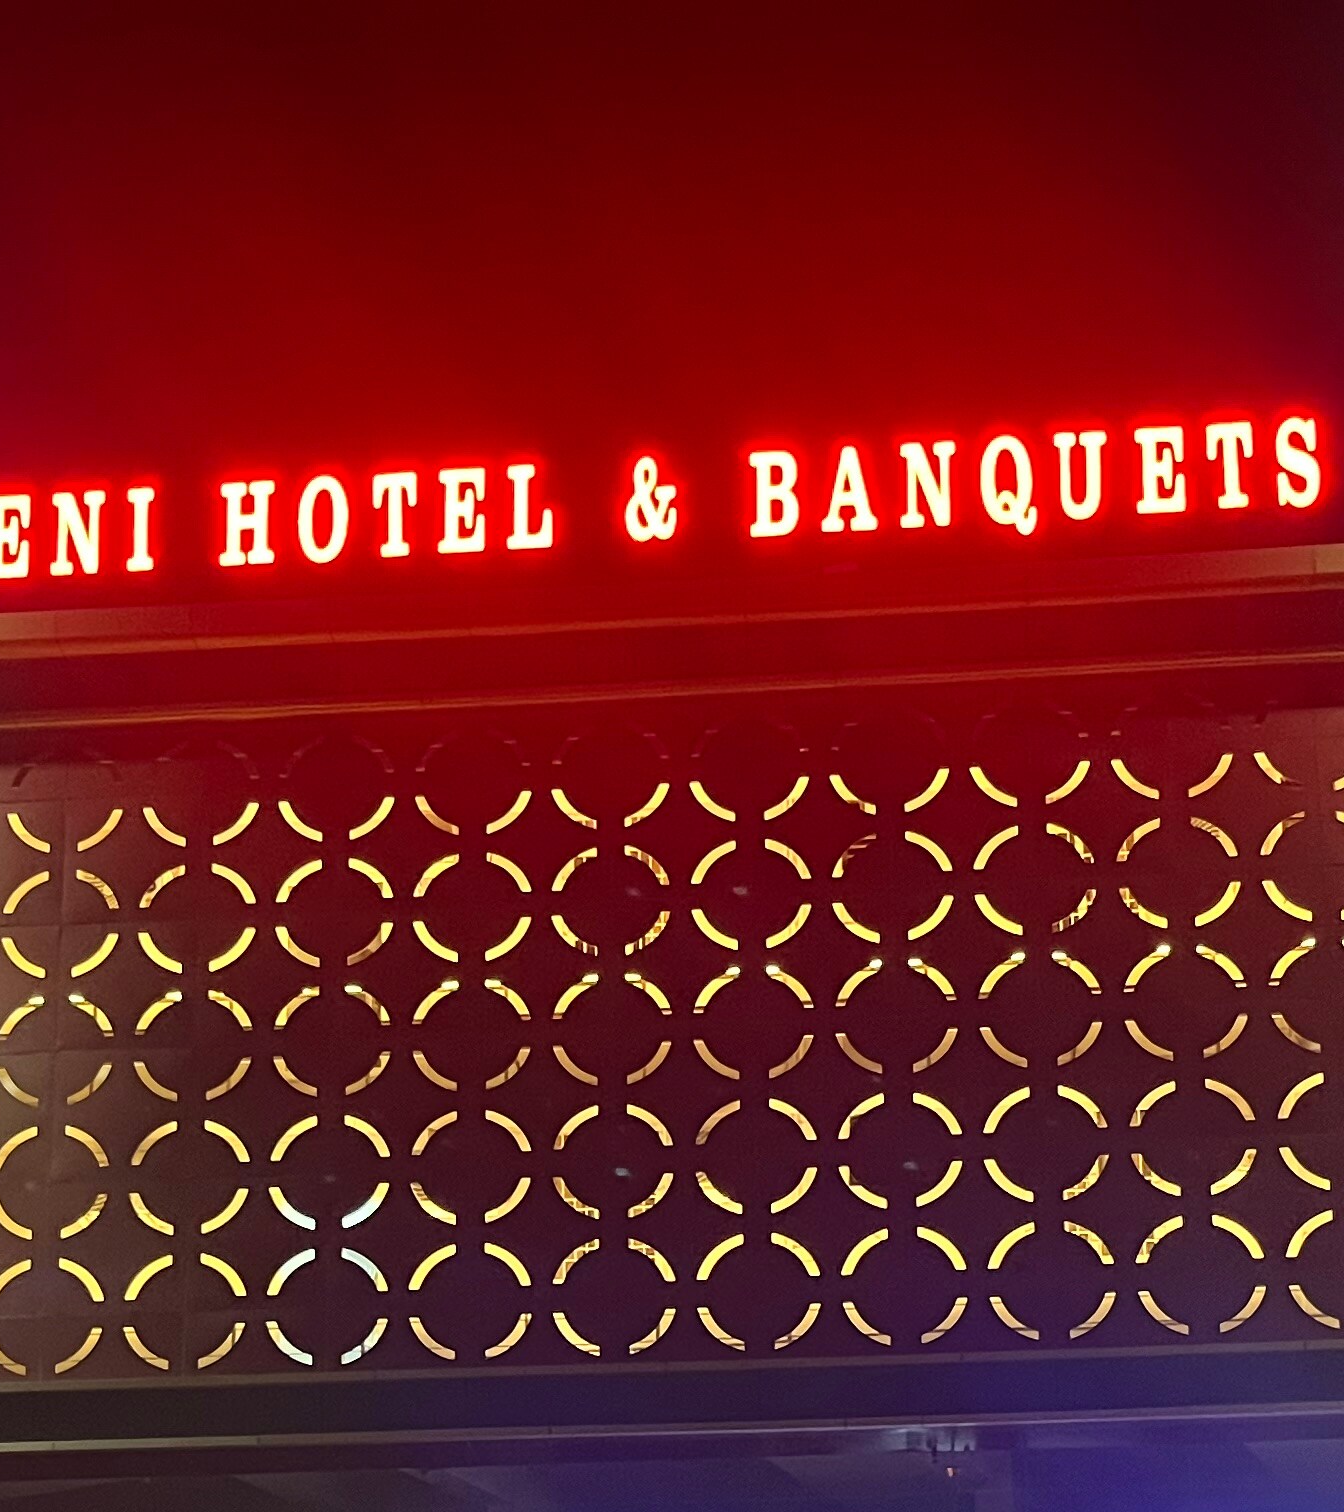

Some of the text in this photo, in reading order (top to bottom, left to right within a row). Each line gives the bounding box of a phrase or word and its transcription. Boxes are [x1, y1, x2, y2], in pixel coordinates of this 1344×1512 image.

[217, 462, 555, 568] HOTEL
[624, 455, 678, 543] &
[747, 415, 1322, 540] BANQUETS
